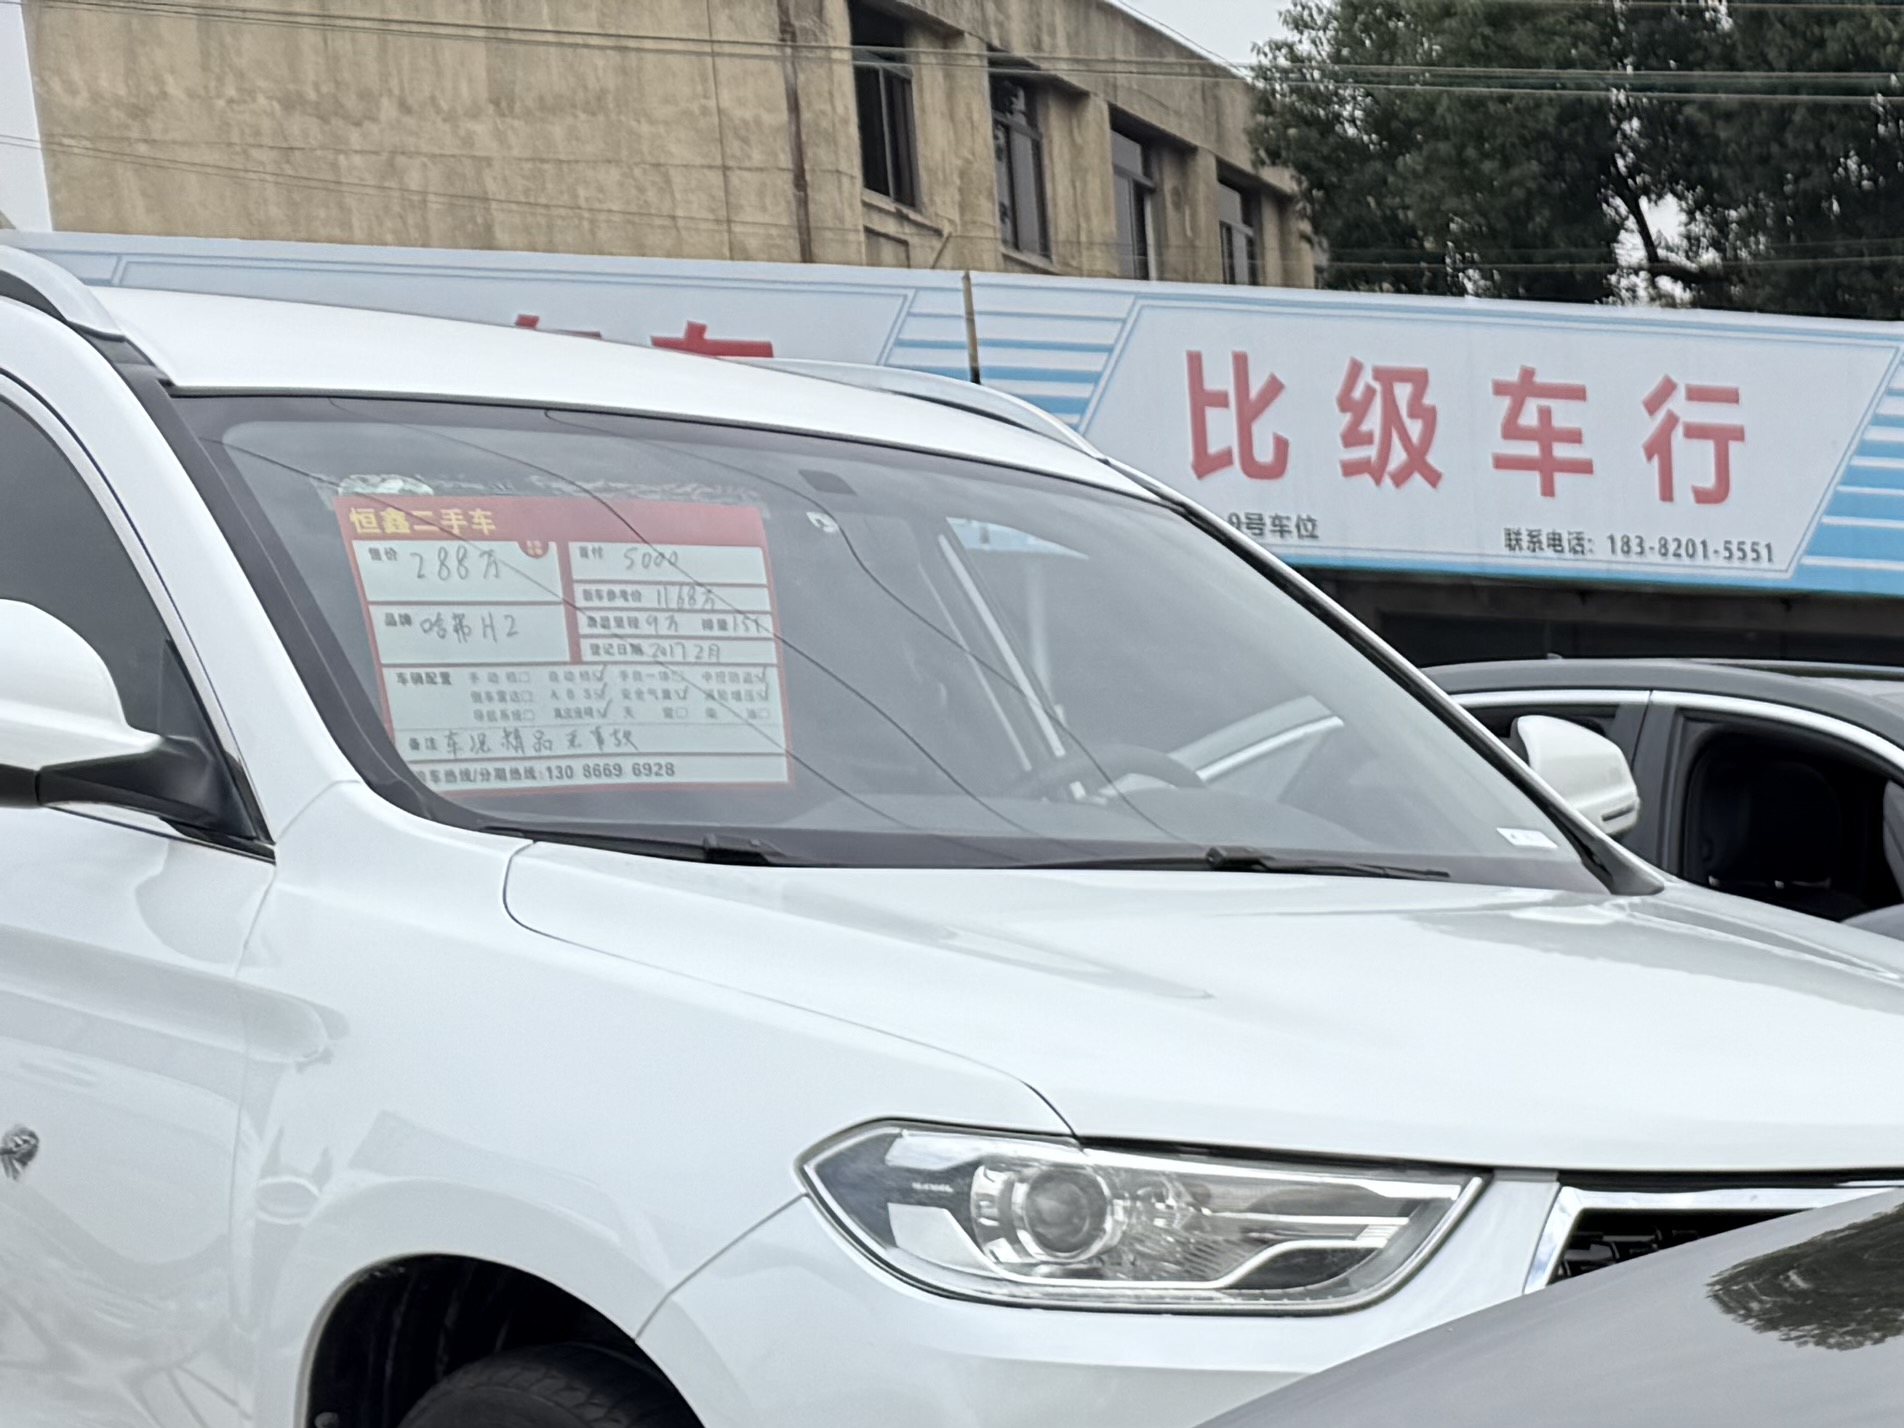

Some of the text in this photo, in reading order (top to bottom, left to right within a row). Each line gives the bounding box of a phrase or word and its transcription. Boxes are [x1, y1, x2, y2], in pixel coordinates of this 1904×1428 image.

[1184, 347, 1748, 509] 比级车行
[349, 506, 497, 537] 恒鑫二手车
[1606, 532, 1776, 564] 183-8201-5551
[582, 762, 623, 779] 8669
[631, 761, 676, 778] 6928
